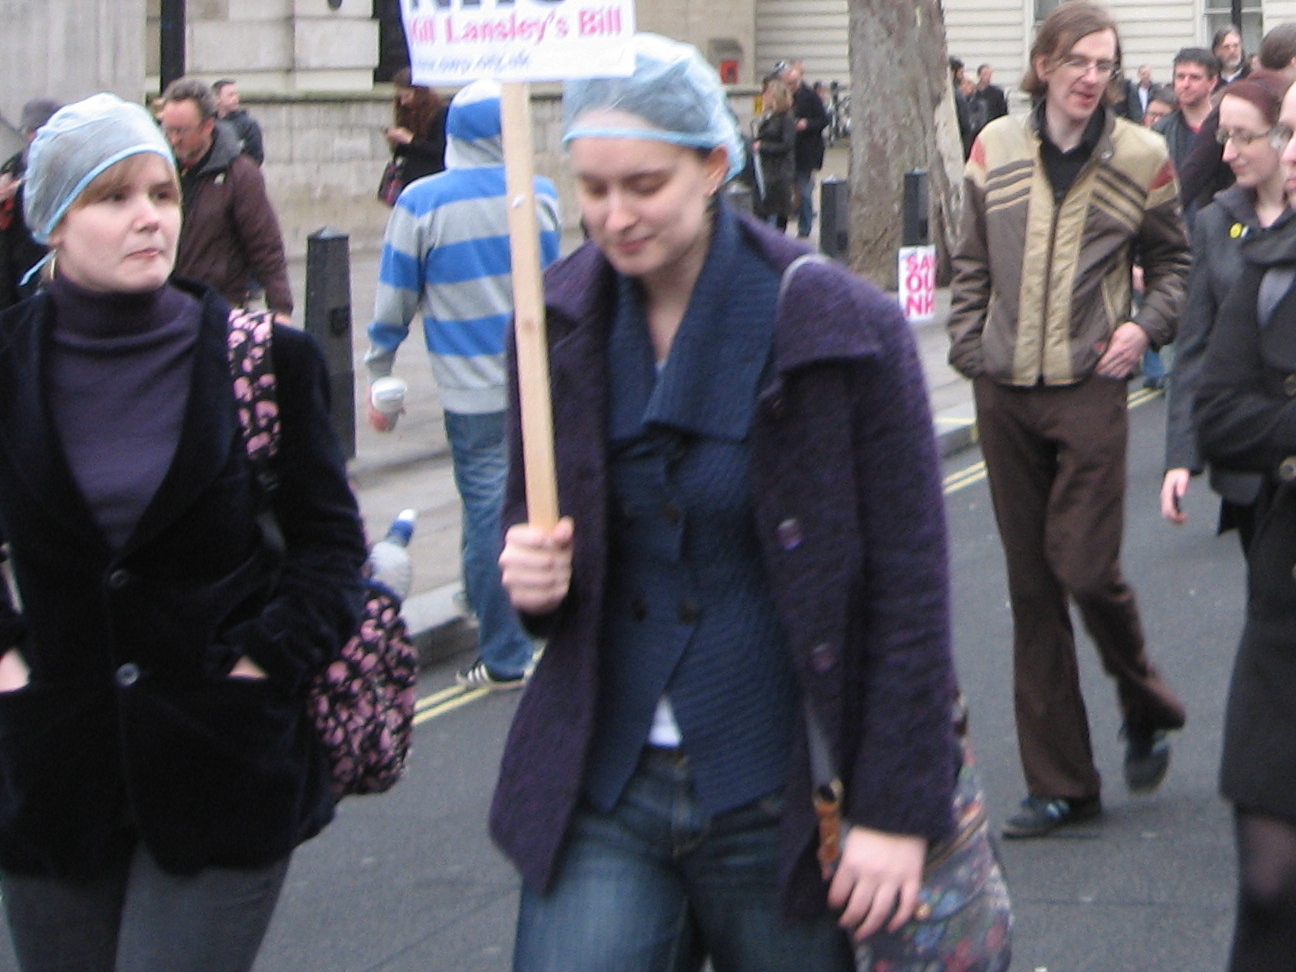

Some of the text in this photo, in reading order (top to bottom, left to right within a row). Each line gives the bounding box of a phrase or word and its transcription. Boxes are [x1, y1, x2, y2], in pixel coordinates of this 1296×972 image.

[445, 11, 568, 44] Lansley's
[578, 8, 622, 36] Bill
[905, 295, 936, 317] NH
